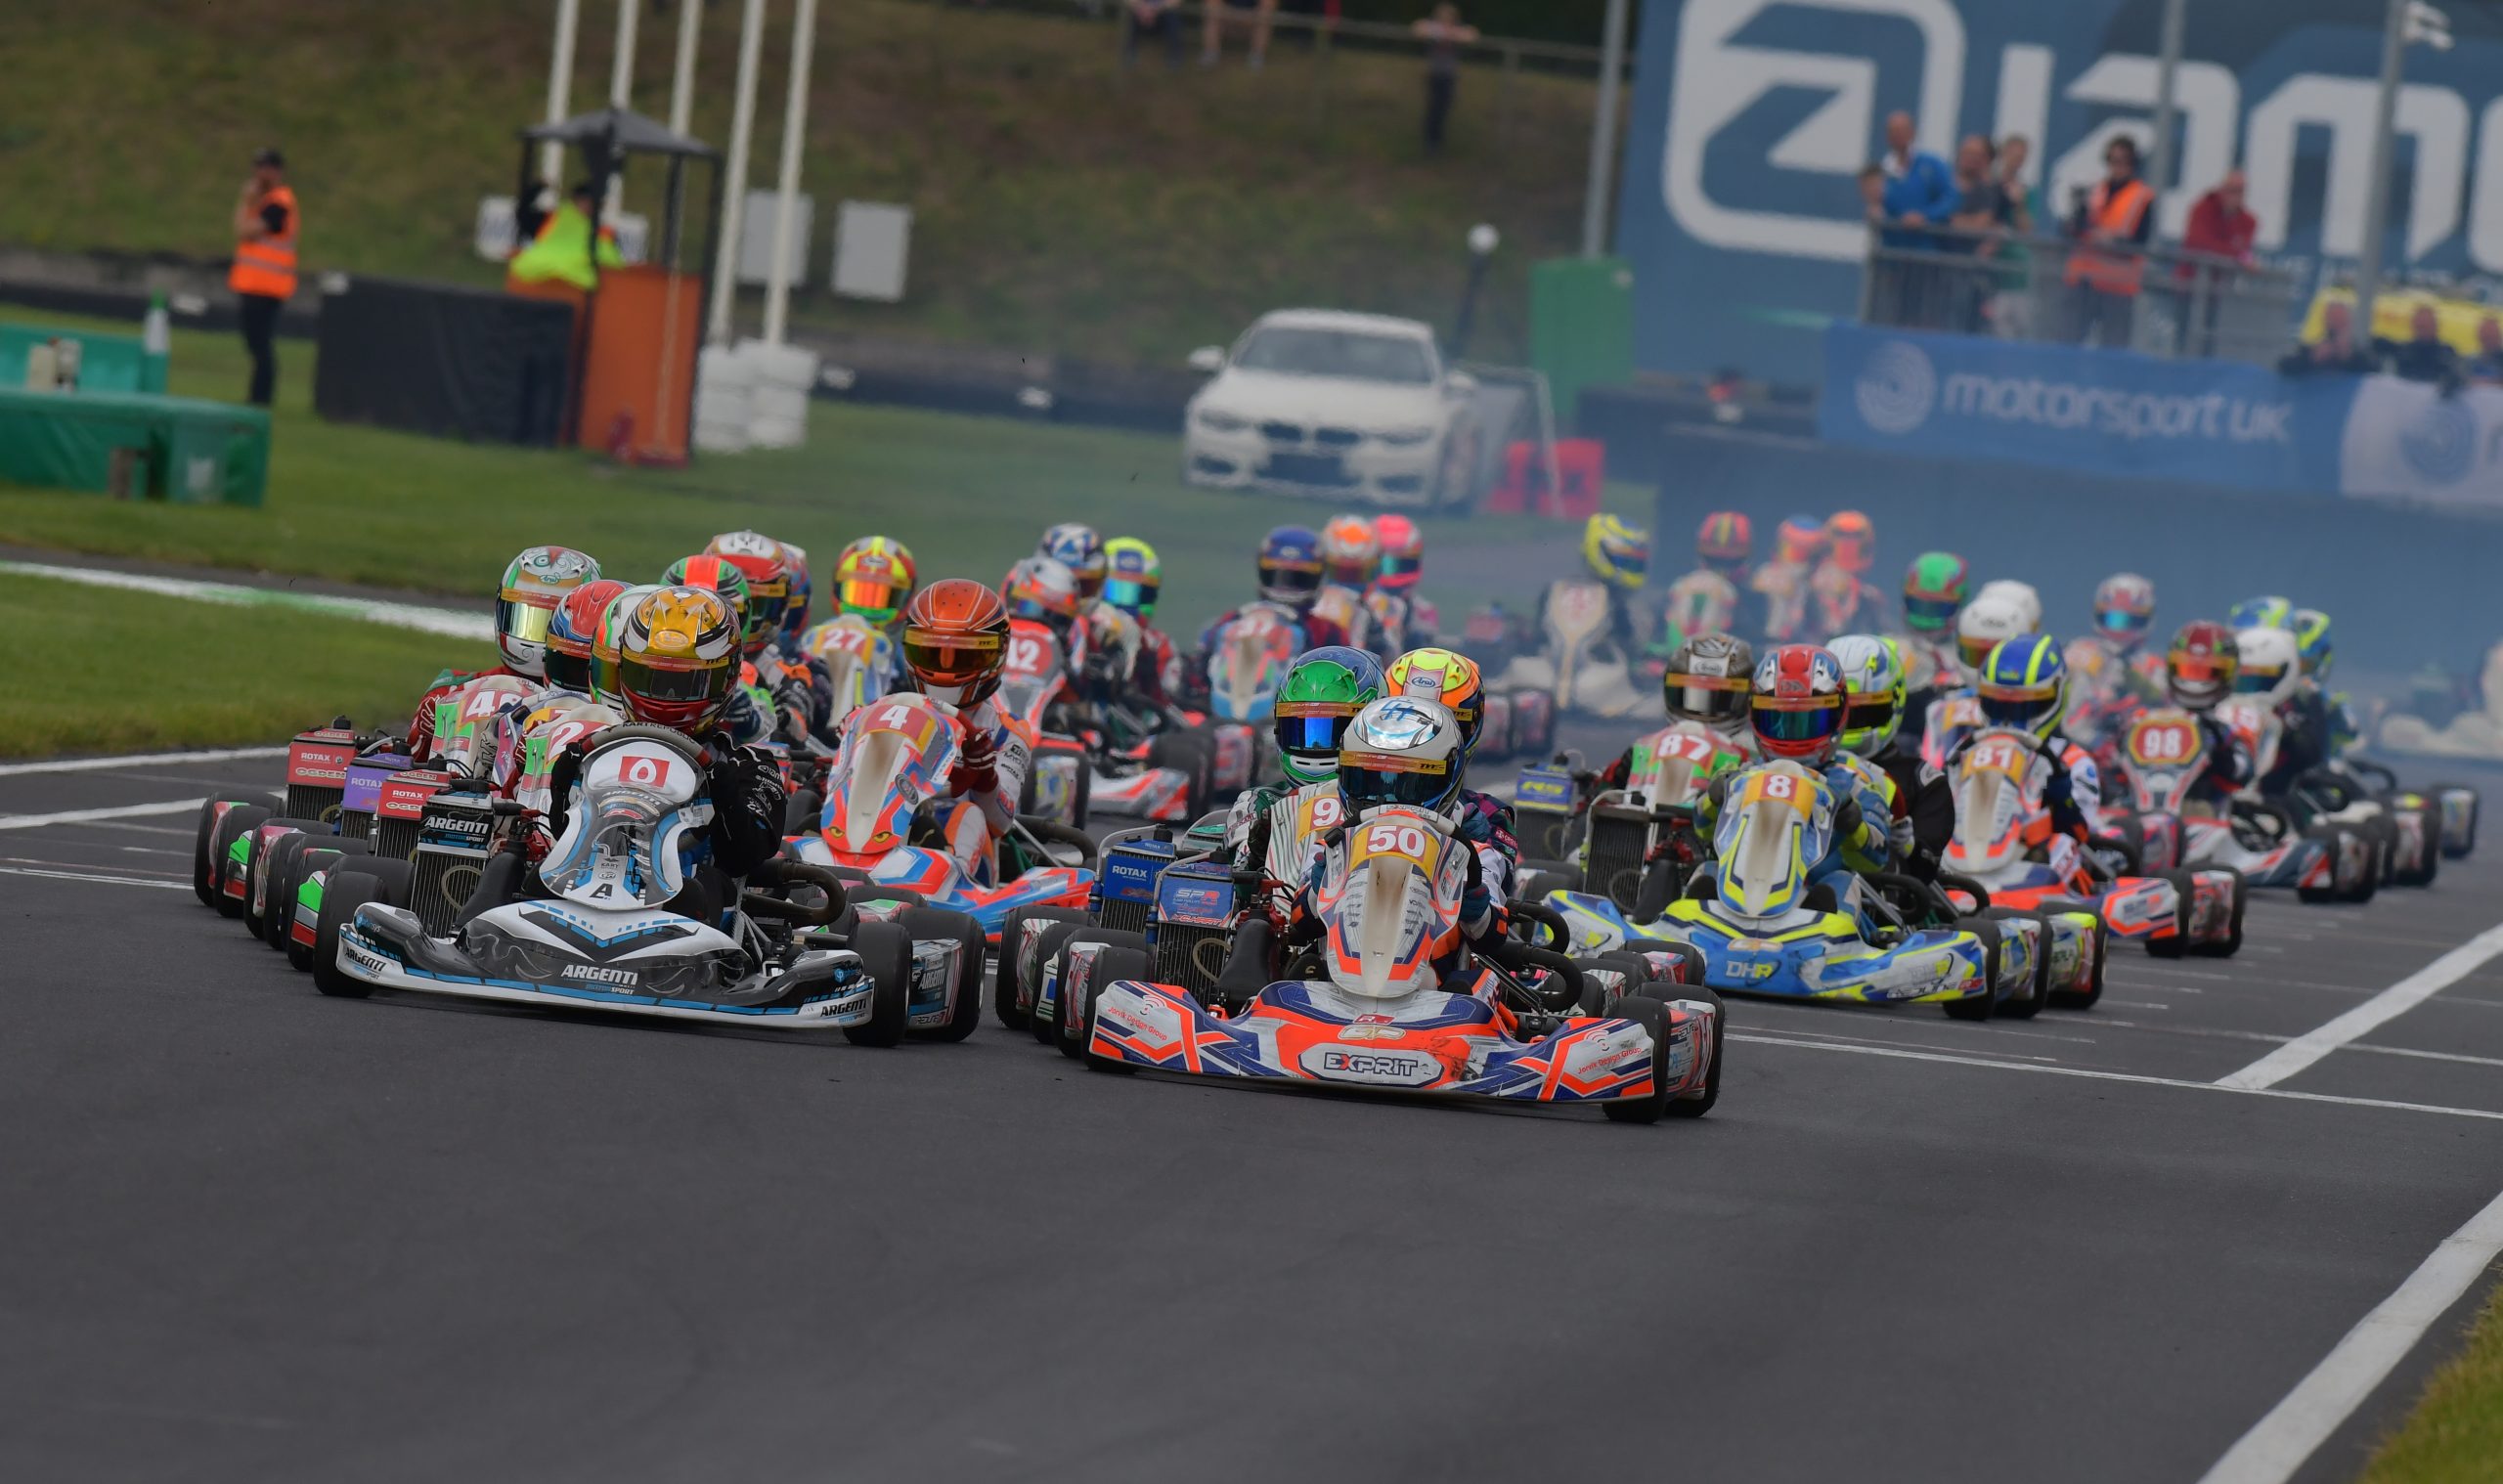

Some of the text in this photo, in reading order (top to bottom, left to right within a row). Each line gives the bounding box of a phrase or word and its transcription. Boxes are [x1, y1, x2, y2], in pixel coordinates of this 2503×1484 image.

[1944, 371, 2222, 441] motorsport
[822, 628, 866, 650] 27
[879, 705, 911, 730] 4
[1658, 733, 1712, 761] 87
[2142, 727, 2182, 759] 98
[301, 752, 330, 762] ROTAX
[1973, 746, 2013, 767] 81
[295, 766, 346, 780] OGDEN
[400, 771, 438, 781] OGDEN
[392, 790, 423, 800] ROTAX
[1767, 774, 1791, 798] 8
[1313, 797, 1345, 827] 9
[424, 816, 489, 834] ARGENTI
[1369, 825, 1426, 857] 50
[1112, 865, 1148, 878] ROTAX
[345, 946, 386, 972] ARGENTI
[560, 964, 638, 985] ARGENTI
[1726, 960, 1773, 980] DHR
[820, 998, 867, 1018] ARGENTI
[1148, 1026, 1167, 1041] Group
[1620, 1046, 1643, 1059] Group
[1323, 1051, 1419, 1077] EXPRIT
